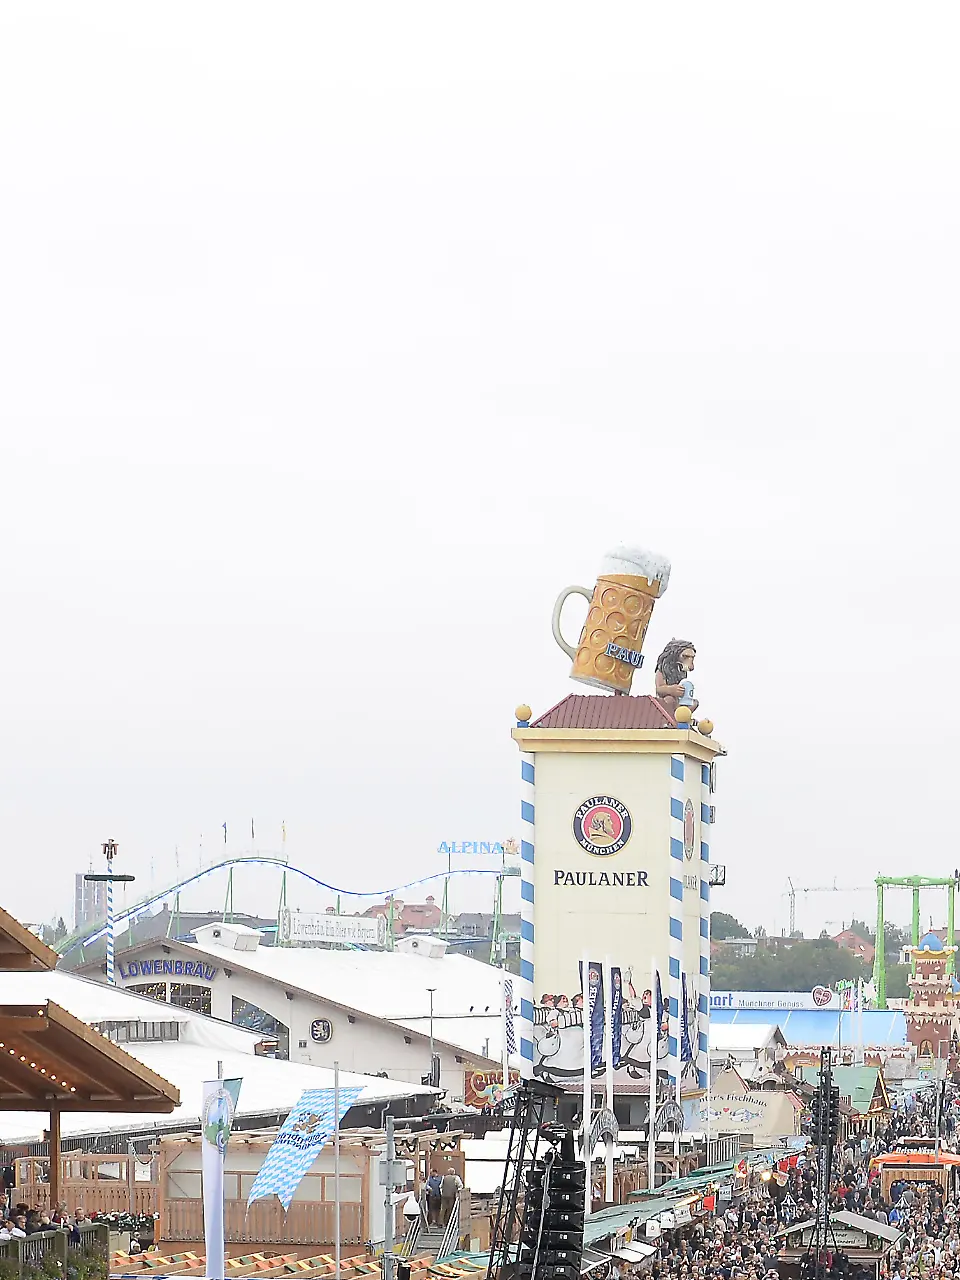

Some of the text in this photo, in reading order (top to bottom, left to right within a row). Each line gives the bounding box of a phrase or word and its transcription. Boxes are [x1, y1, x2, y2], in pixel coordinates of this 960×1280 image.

[575, 796, 629, 819] PAULANER
[439, 841, 503, 854] ALPINA
[580, 839, 625, 855] MÜNCHEN
[553, 870, 649, 887] PAULANER
[117, 960, 216, 981] LÖWENBRÄU
[726, 1093, 768, 1108] Fischhaus
